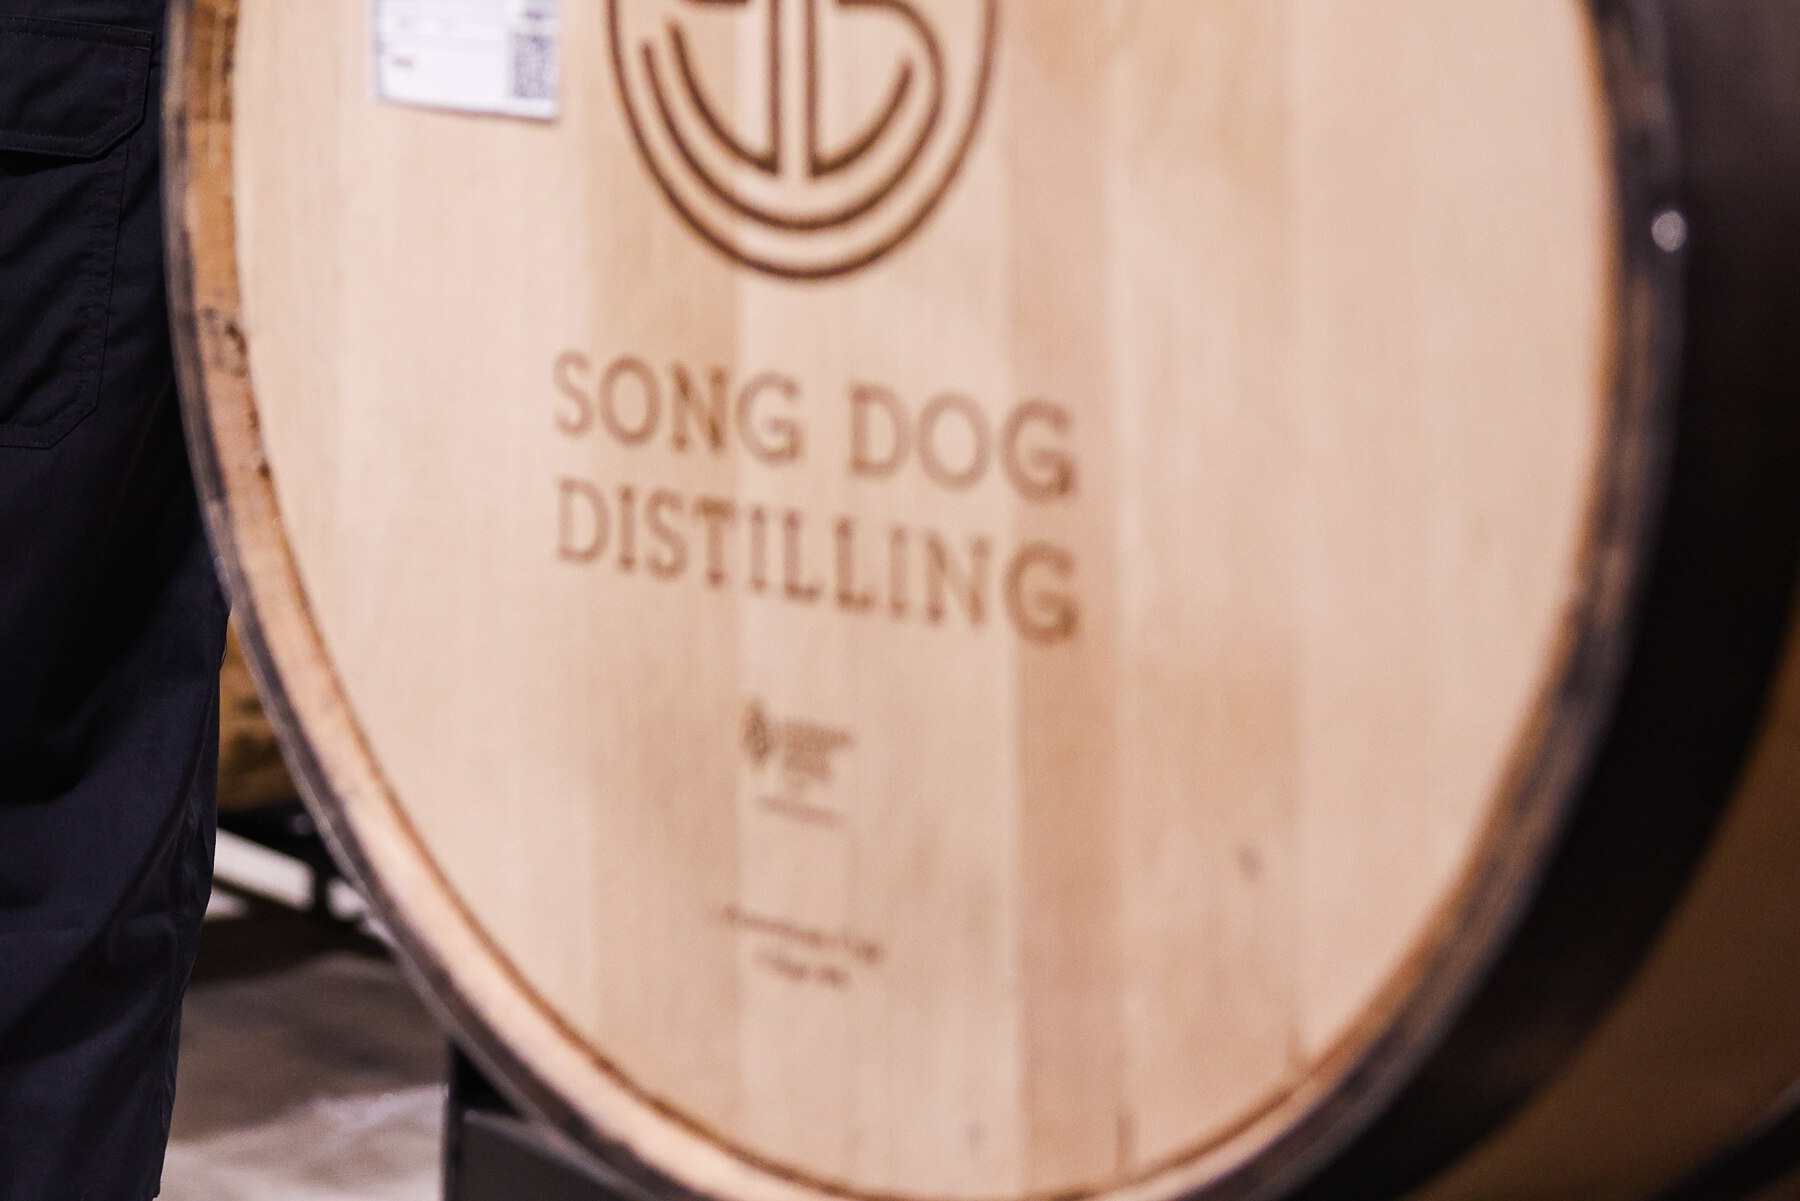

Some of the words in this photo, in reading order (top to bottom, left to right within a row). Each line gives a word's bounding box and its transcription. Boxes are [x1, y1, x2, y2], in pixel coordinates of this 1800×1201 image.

[552, 349, 803, 466] SONG
[848, 381, 1078, 502] DOG
[556, 476, 1081, 646] DISTILLING
